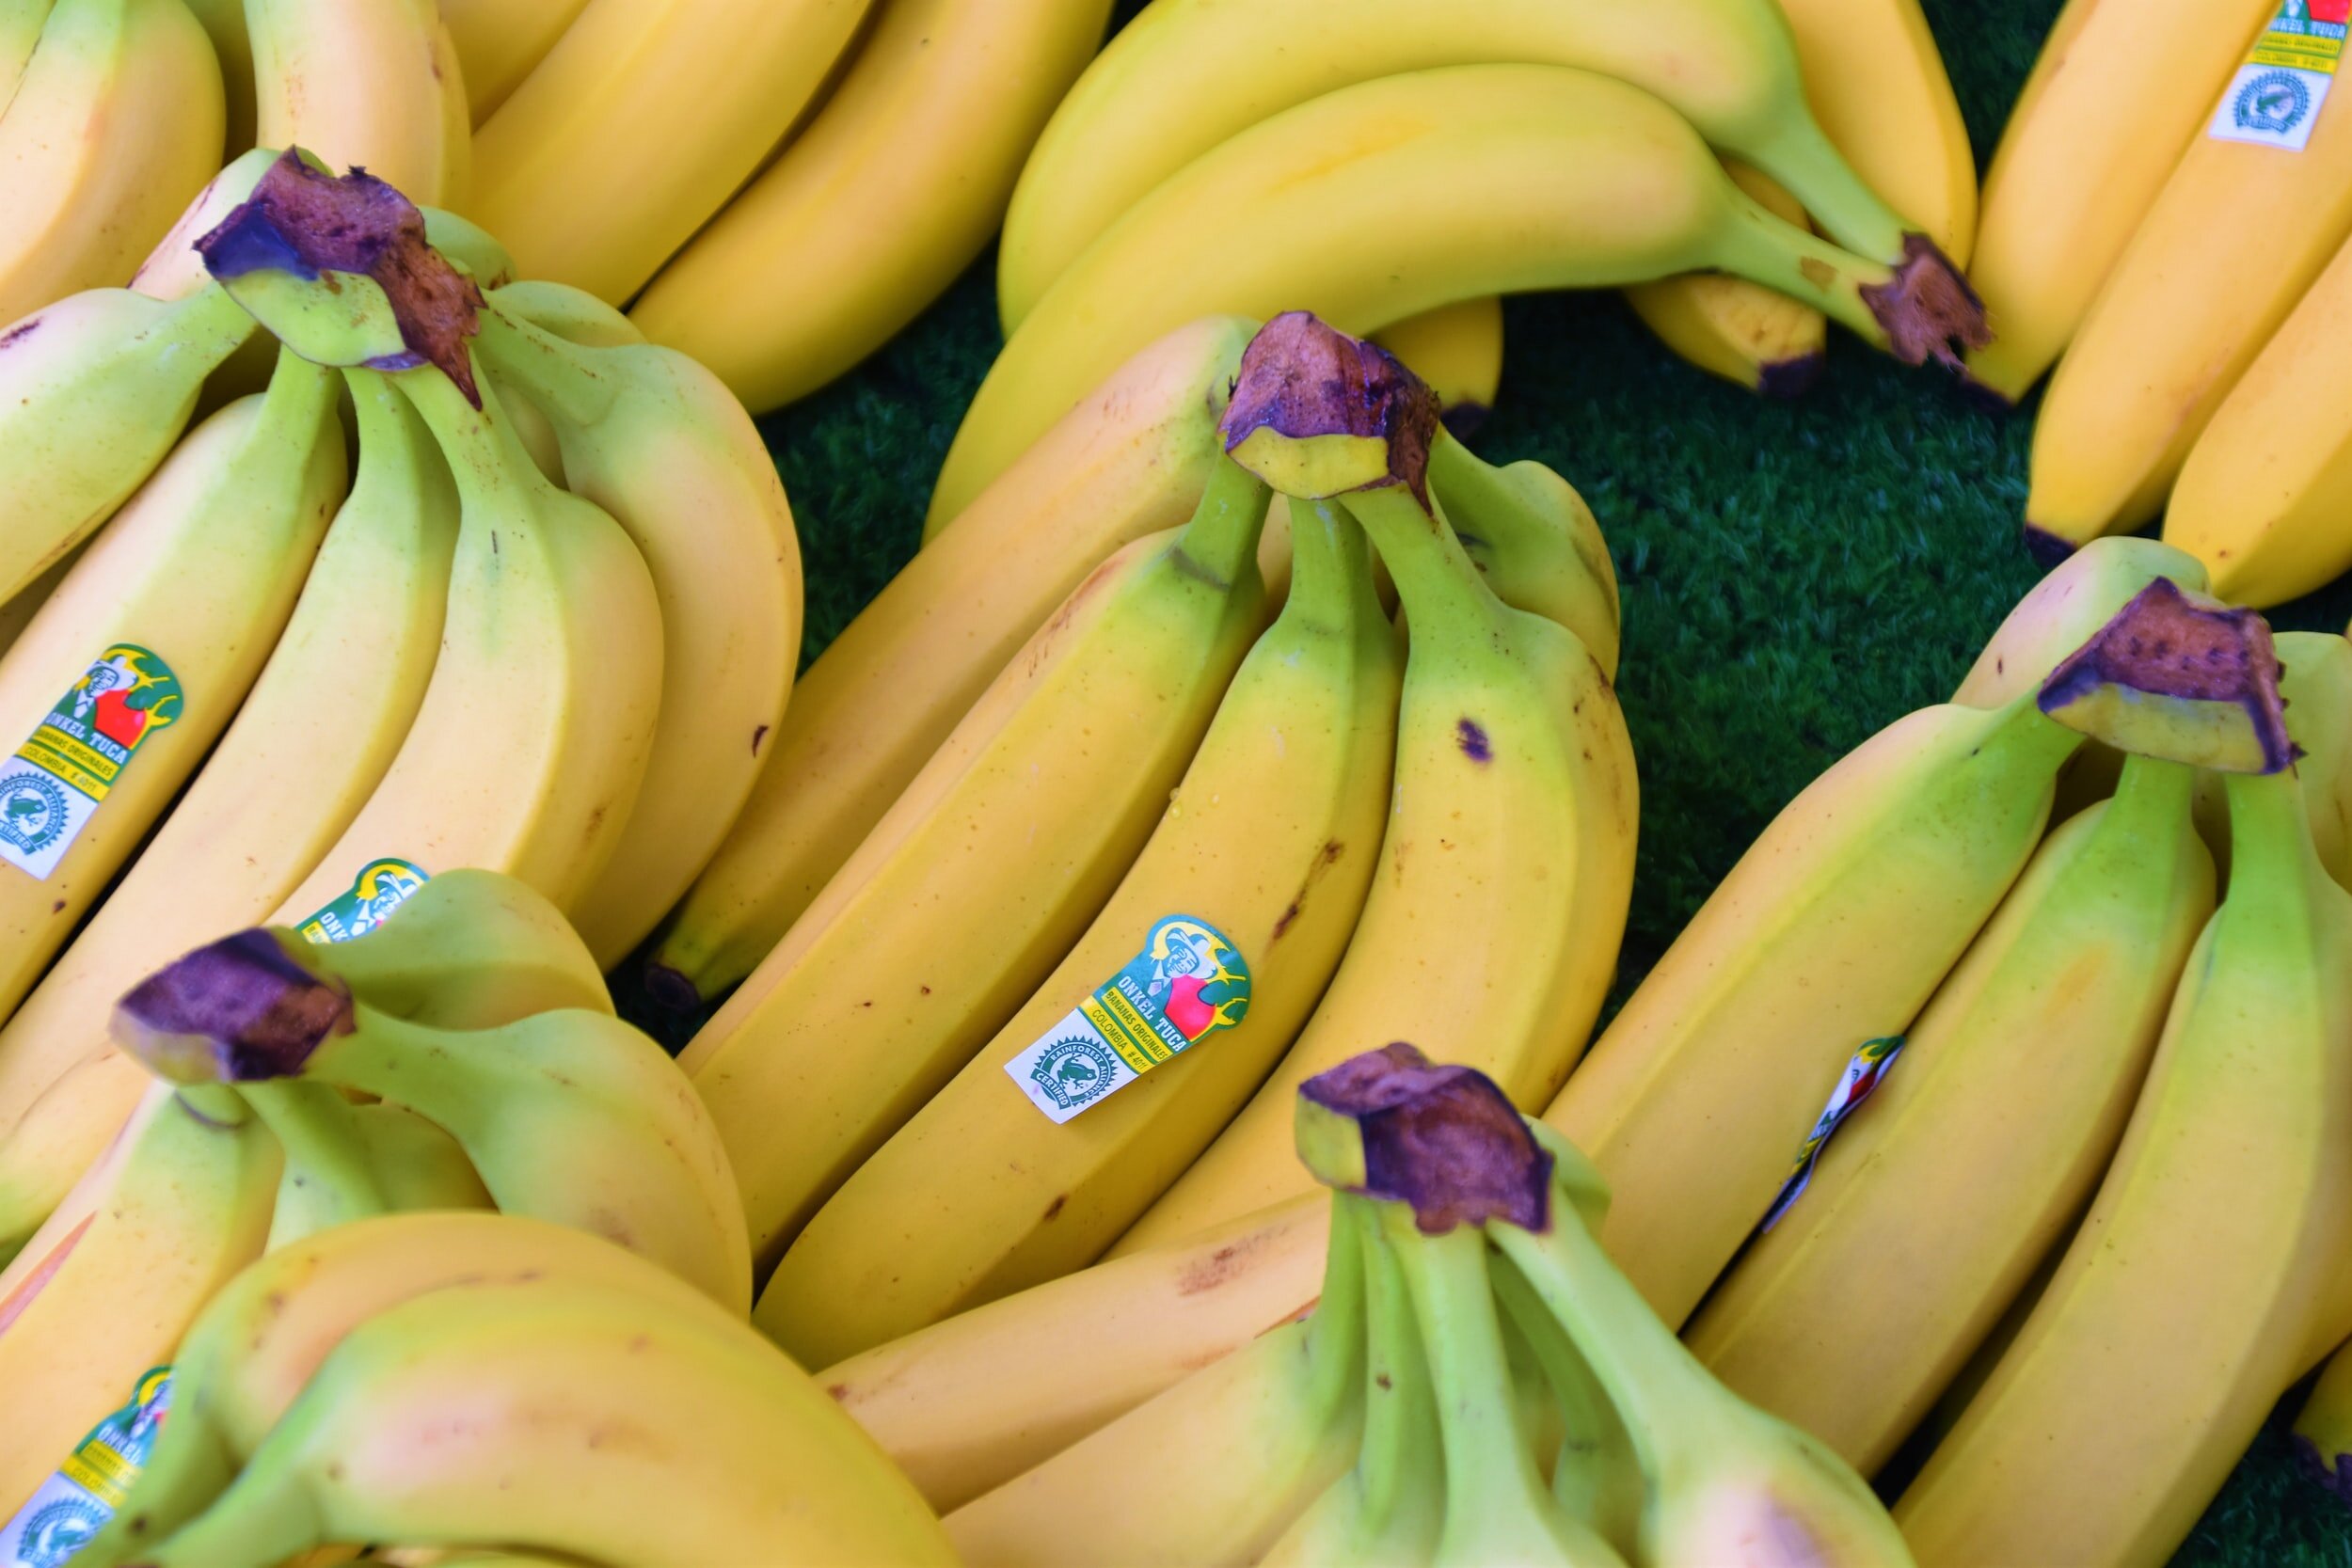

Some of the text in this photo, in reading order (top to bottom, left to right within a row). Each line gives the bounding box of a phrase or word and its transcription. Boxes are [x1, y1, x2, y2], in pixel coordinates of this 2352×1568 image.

[2269, 17, 2305, 34] NKEL
[24, 745, 66, 774] COLOMBIA
[68, 743, 114, 777] ORIGINALES
[88, 732, 129, 764] TUCA
[0, 780, 46, 799] INFOREST
[320, 911, 349, 942] ONK
[1091, 1009, 1127, 1051] COLOMBIA
[1104, 990, 1168, 1060] BANANAS ORIGINALES
[1117, 975, 1187, 1053] ONKEL TUCA
[1050, 1044, 1108, 1098] RAINFOREST ALLIANCE
[1036, 1072, 1069, 1106] CERTIFIED
